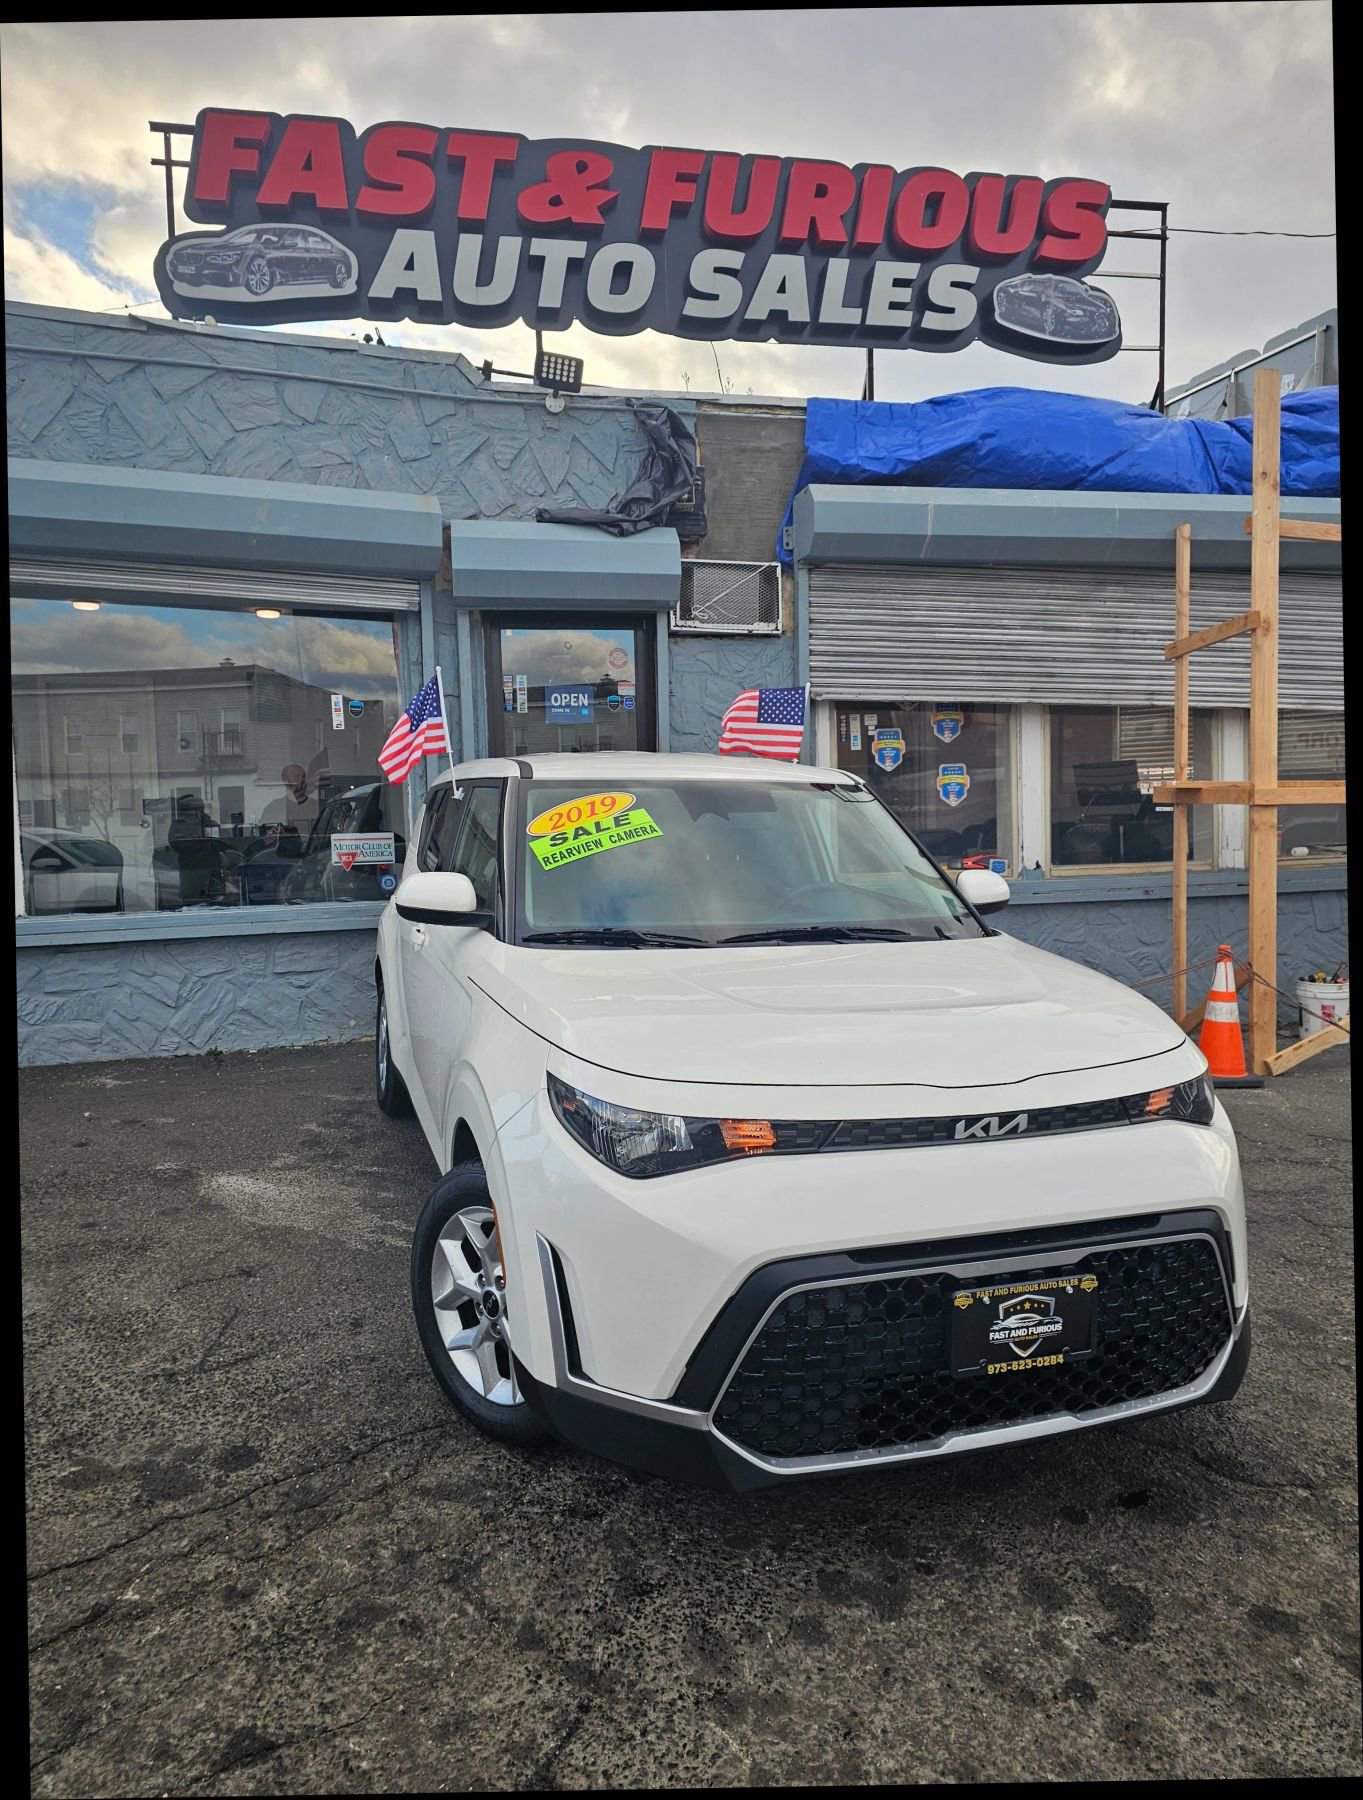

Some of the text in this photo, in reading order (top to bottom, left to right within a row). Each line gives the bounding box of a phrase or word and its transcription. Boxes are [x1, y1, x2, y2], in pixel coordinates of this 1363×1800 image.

[193, 111, 1112, 263] FAST & FURIOUS
[366, 227, 982, 332] AUTO SALES
[551, 693, 589, 707] OPEN
[549, 795, 617, 832] 2019
[549, 813, 632, 848] SALE
[333, 843, 361, 851] MOTOR
[362, 842, 383, 851] CLUB
[542, 824, 658, 867] REARVIEW CAMERA
[954, 1113, 1028, 1139] KIA
[976, 1290, 993, 1299] FAST
[993, 1288, 1009, 1296] AND
[1009, 1284, 1039, 1294] FURIOUS
[1039, 1281, 1057, 1290] AUTO
[1058, 1278, 1078, 1288] SALES
[989, 1323, 1063, 1341] FAST AND FURIOUS
[987, 1353, 1065, 1375] 973-623-0284
